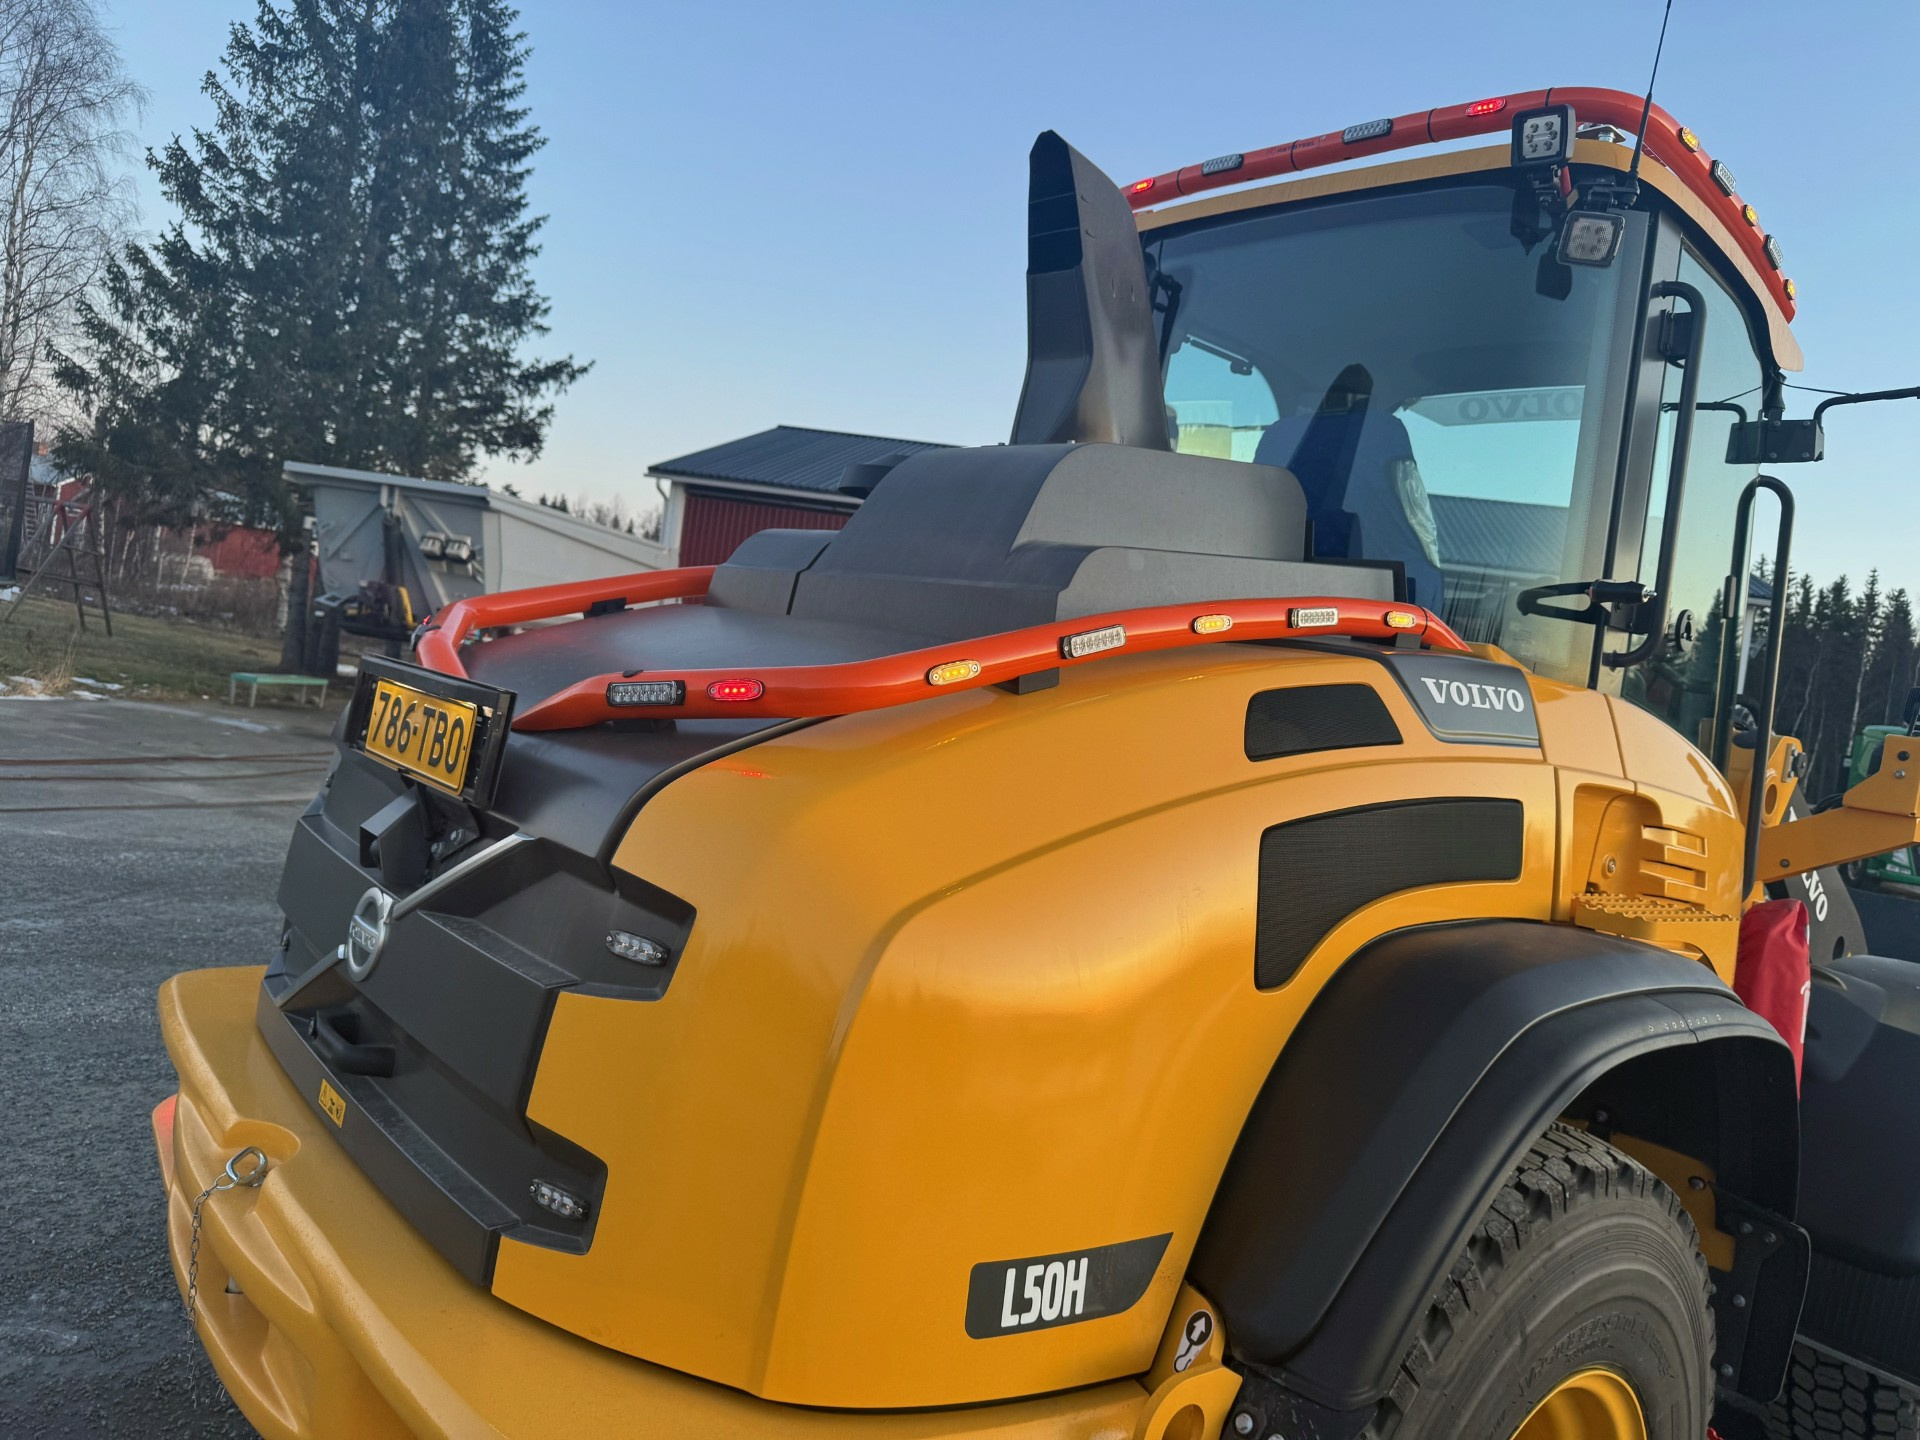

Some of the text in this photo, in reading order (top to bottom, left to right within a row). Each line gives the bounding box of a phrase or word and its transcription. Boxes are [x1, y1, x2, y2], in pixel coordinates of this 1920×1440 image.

[1421, 677, 1525, 713] VOLVO
[371, 690, 465, 774] 786-TBO
[1001, 1257, 1089, 1328] L50H
